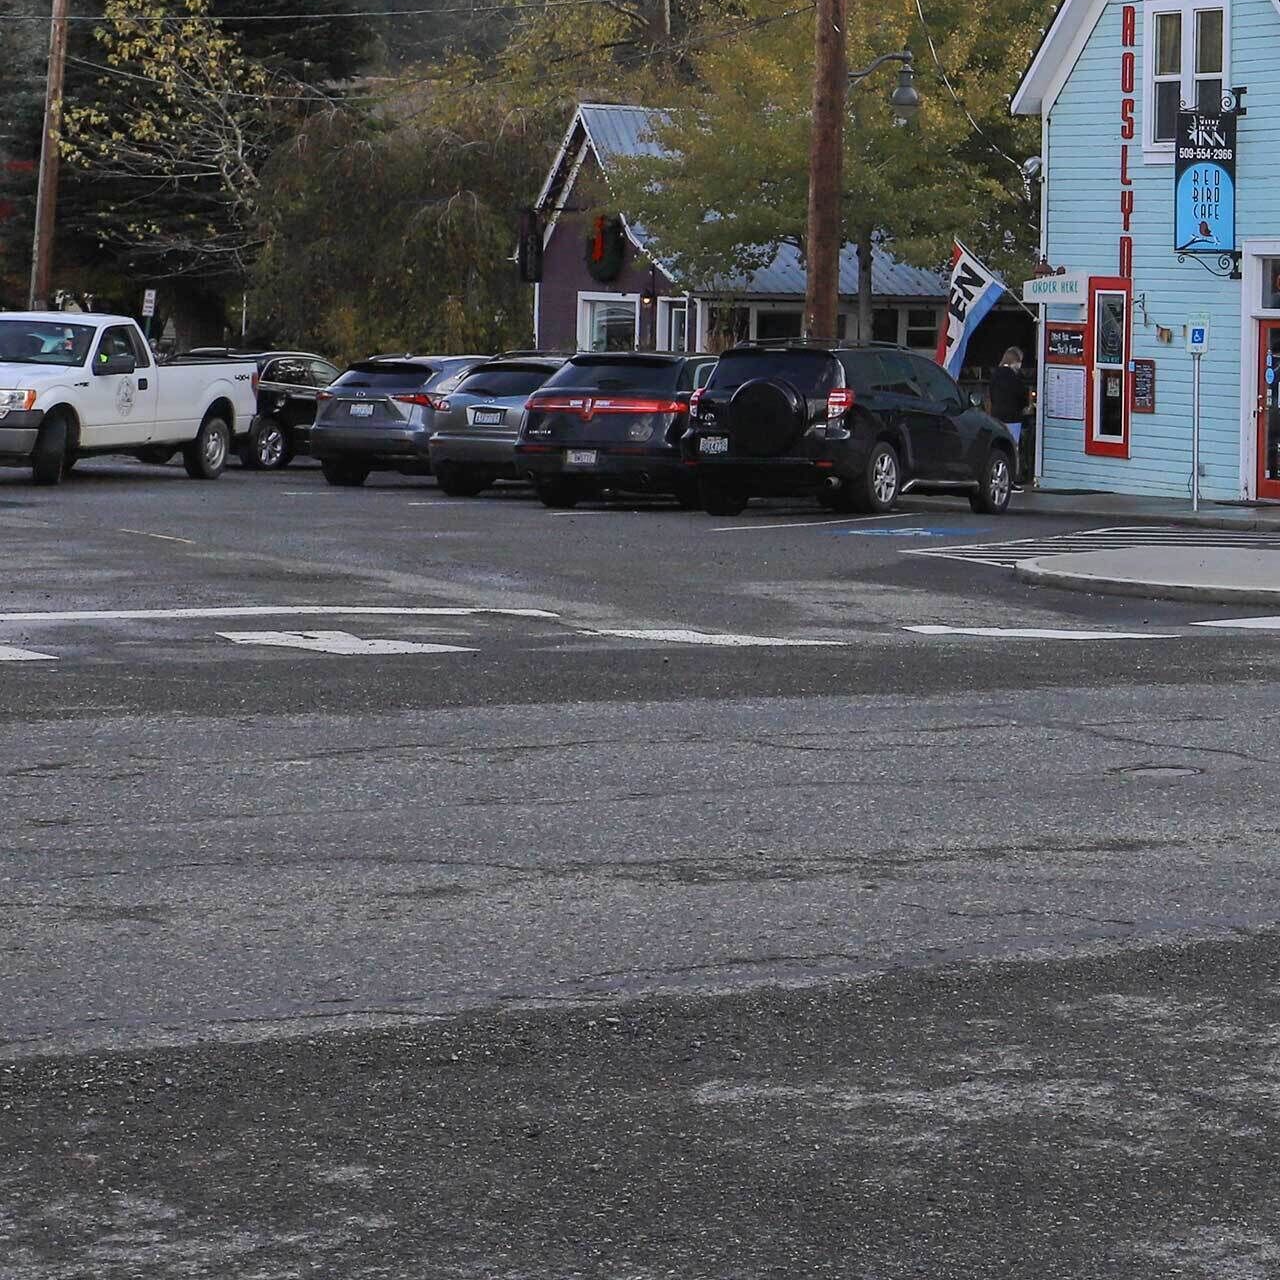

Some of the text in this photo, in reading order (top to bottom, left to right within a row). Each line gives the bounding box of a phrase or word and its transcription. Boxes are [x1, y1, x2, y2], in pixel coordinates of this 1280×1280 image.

[1198, 131, 1226, 146] INN
[1179, 147, 1233, 160] 509-554-2966
[1193, 169, 1220, 186] RED
[1192, 186, 1220, 203] BIRD
[1193, 203, 1221, 220] CAFE
[1032, 280, 1079, 294] ORDER HERE
